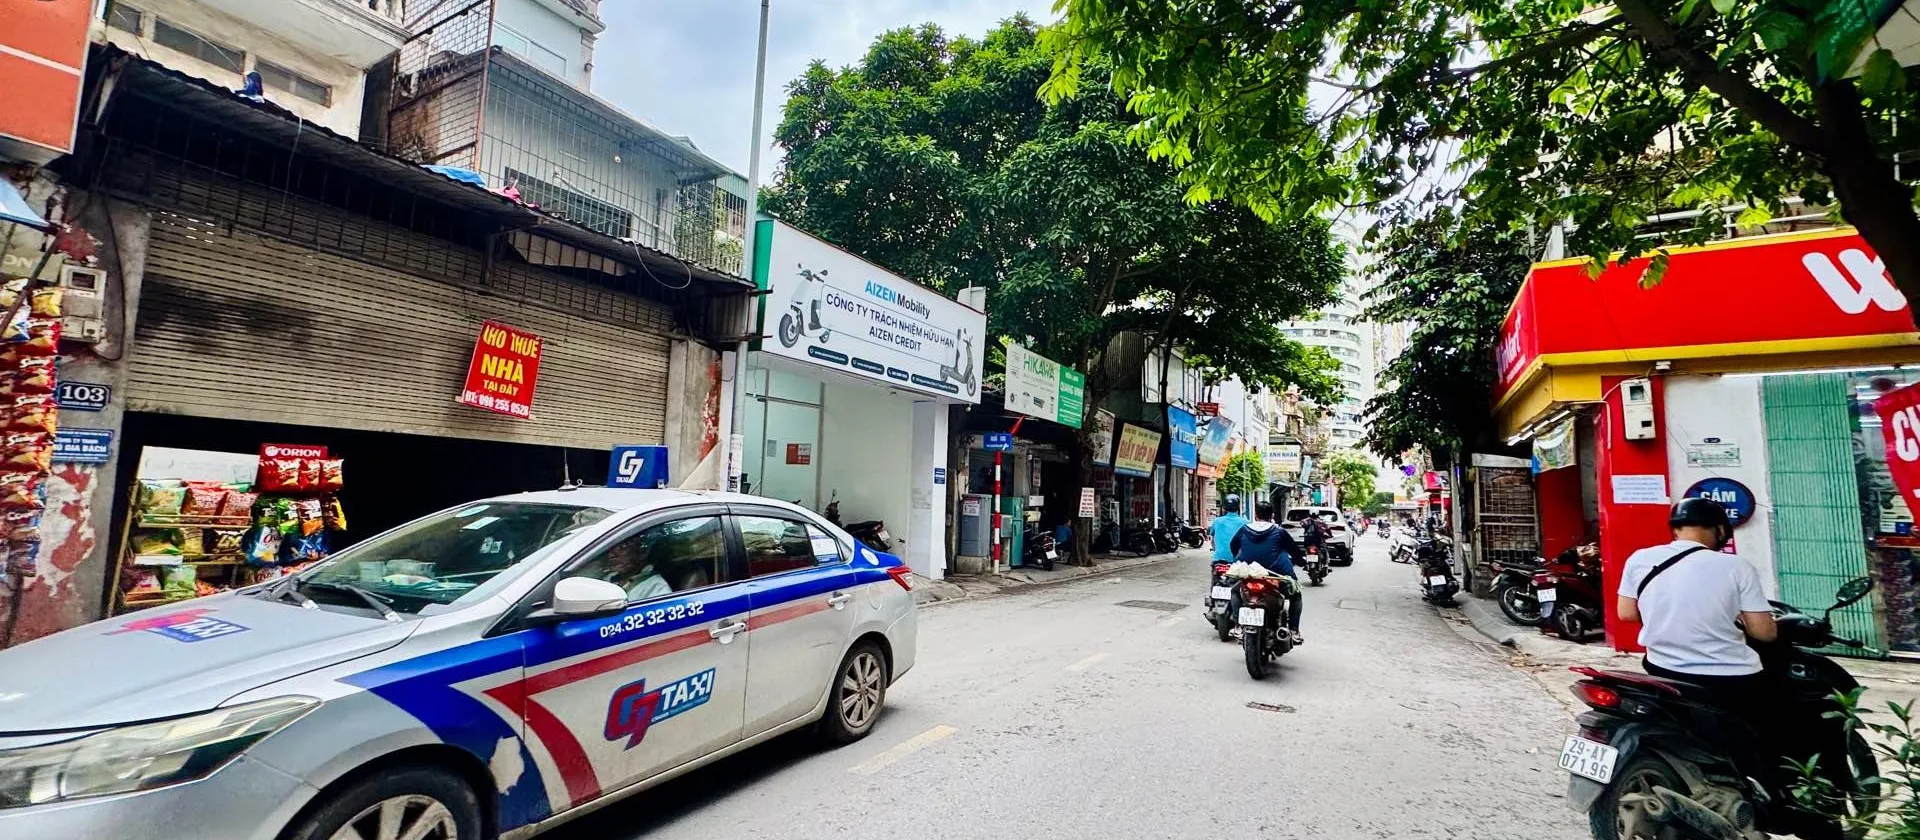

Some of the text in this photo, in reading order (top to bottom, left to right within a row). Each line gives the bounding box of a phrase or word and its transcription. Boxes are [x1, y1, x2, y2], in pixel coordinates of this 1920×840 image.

[864, 280, 931, 319] AIZEN Mobility
[826, 293, 955, 349] CÔNG TY TRÁCH NHIỆM HỮU HẠN
[869, 326, 922, 352] AIZEN CREDIT
[480, 353, 524, 385] NHÀ
[61, 385, 105, 402] 103
[281, 448, 321, 457] ORION
[619, 450, 645, 484] G7
[646, 608, 666, 626] 32
[667, 604, 686, 621] 32
[686, 600, 705, 617] 32
[661, 670, 714, 711] TAXI
[604, 678, 660, 751] G7
[1561, 752, 1609, 780] 071.96
